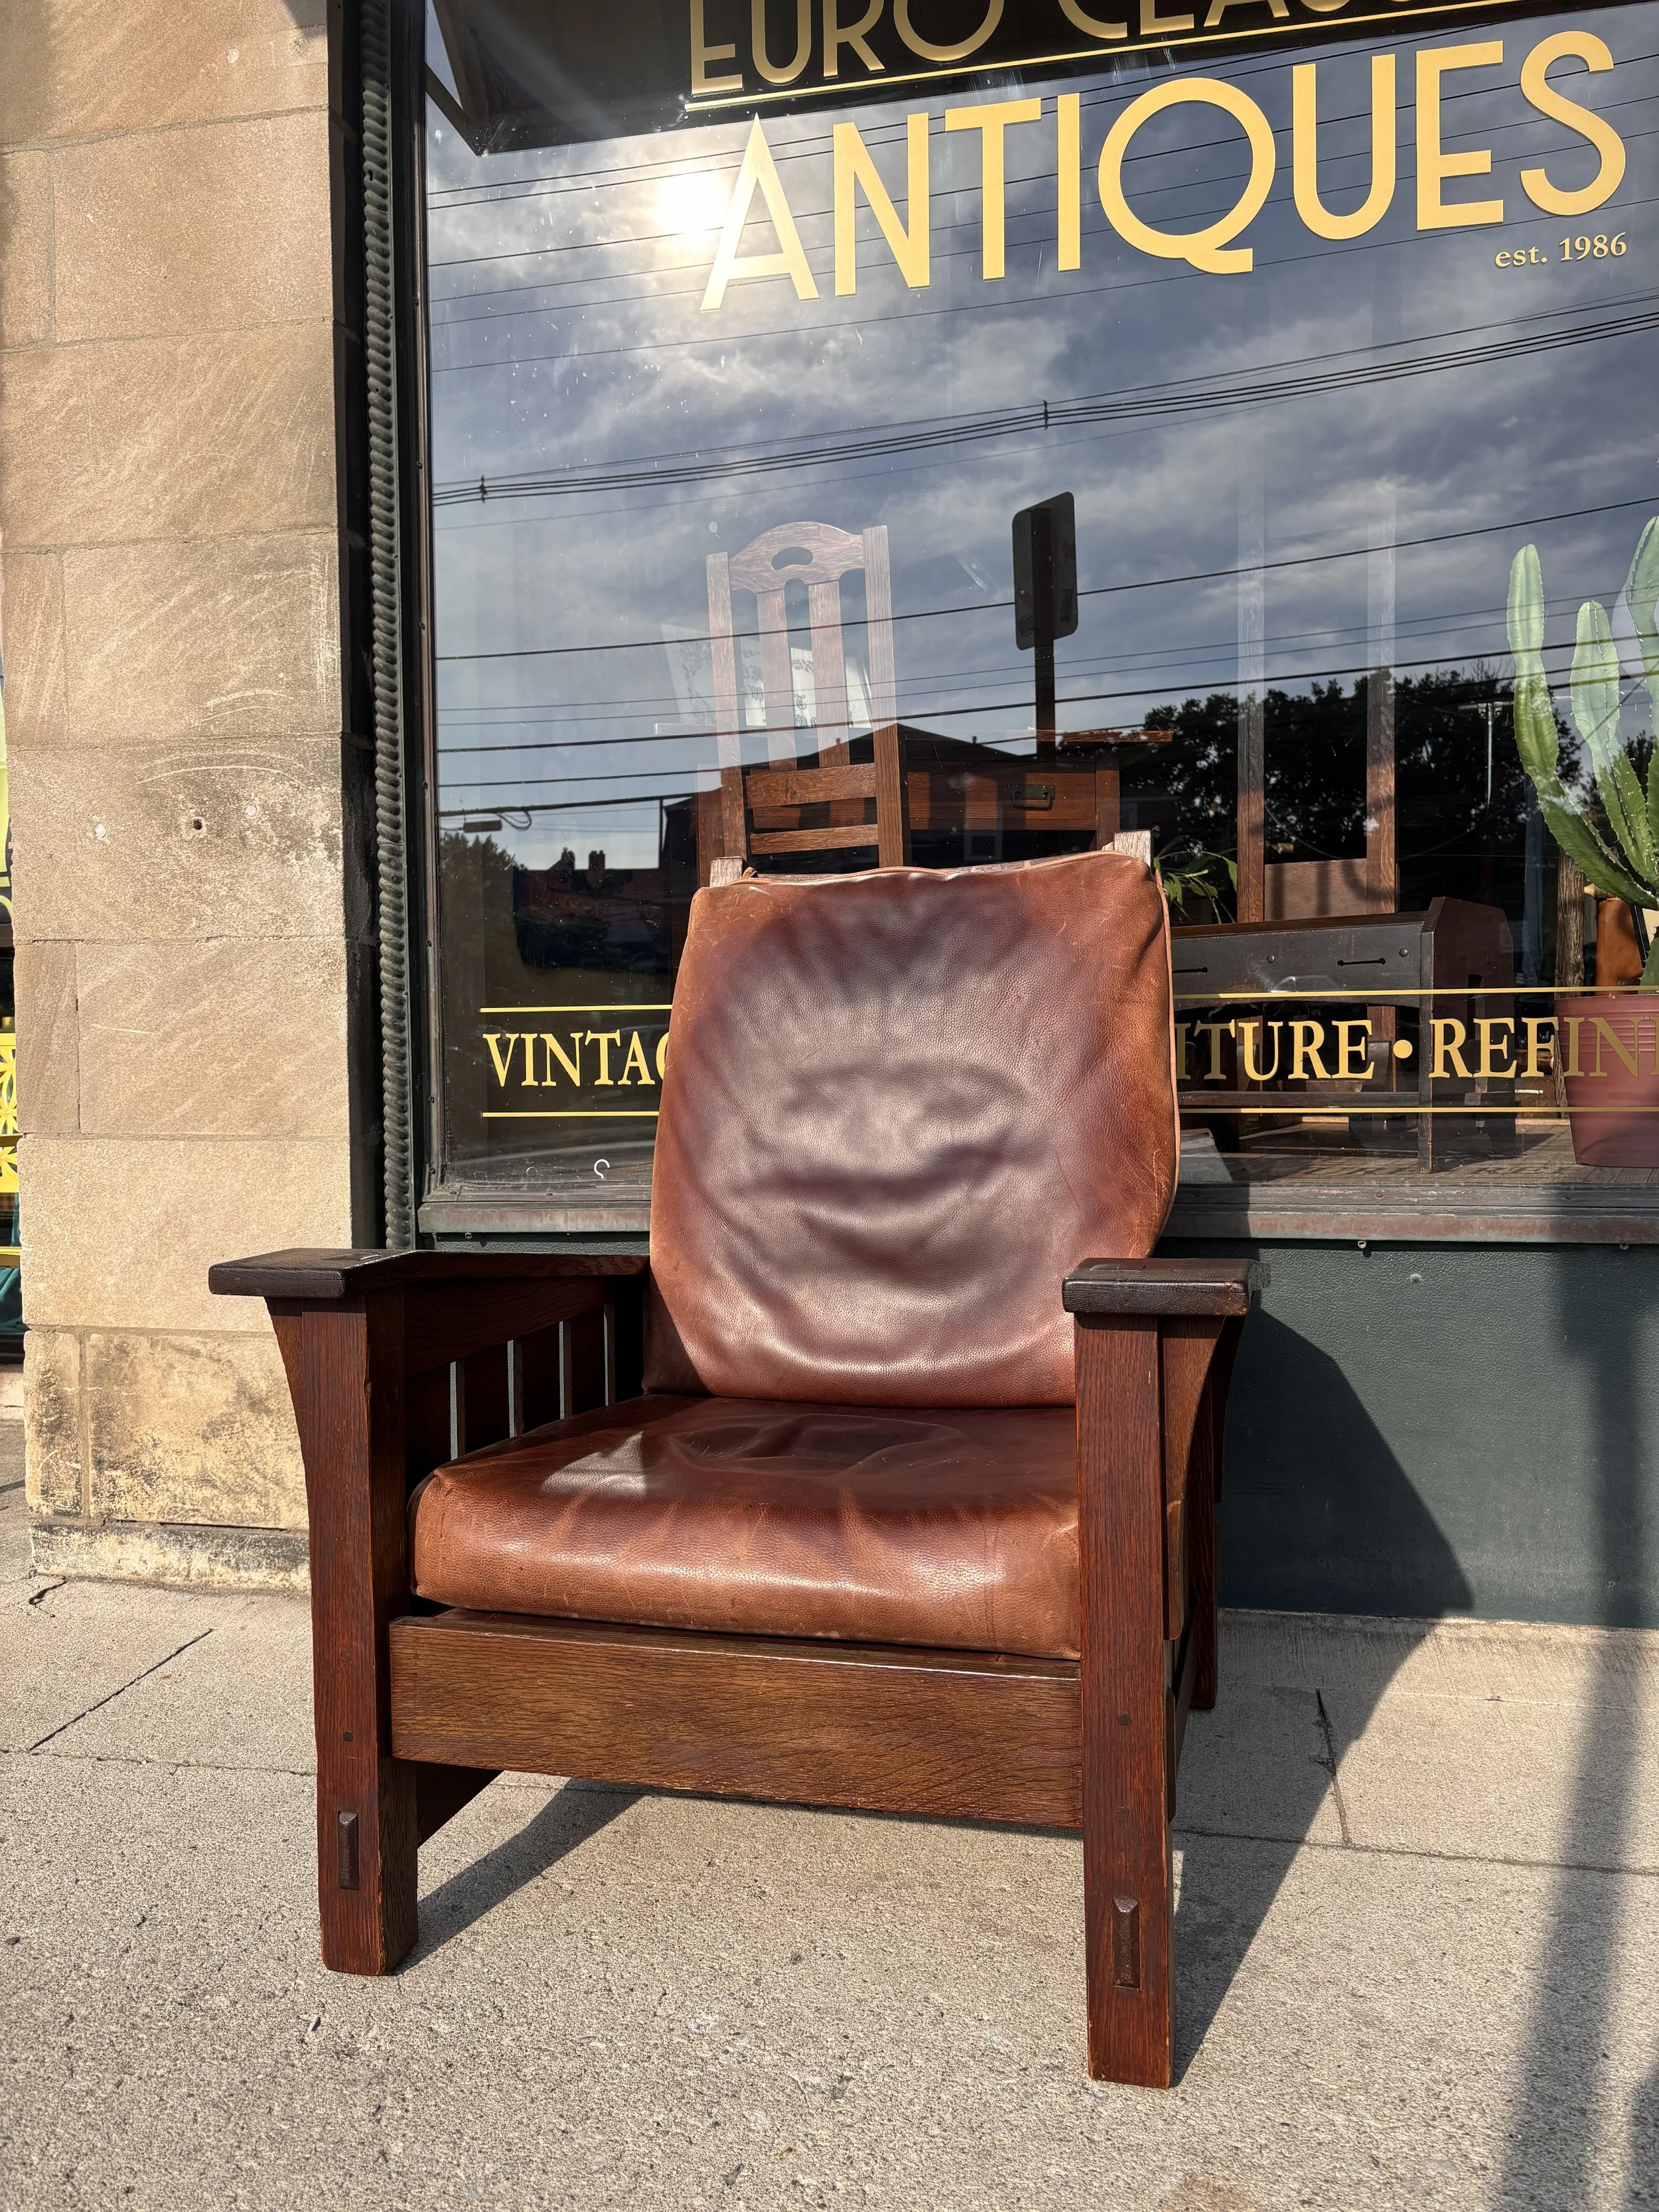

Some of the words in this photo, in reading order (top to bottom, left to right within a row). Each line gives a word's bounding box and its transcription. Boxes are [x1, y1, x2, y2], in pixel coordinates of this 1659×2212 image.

[700, 31, 1626, 311] ANTIQUES
[1494, 246, 1548, 267] est.
[1559, 232, 1627, 261] 1986
